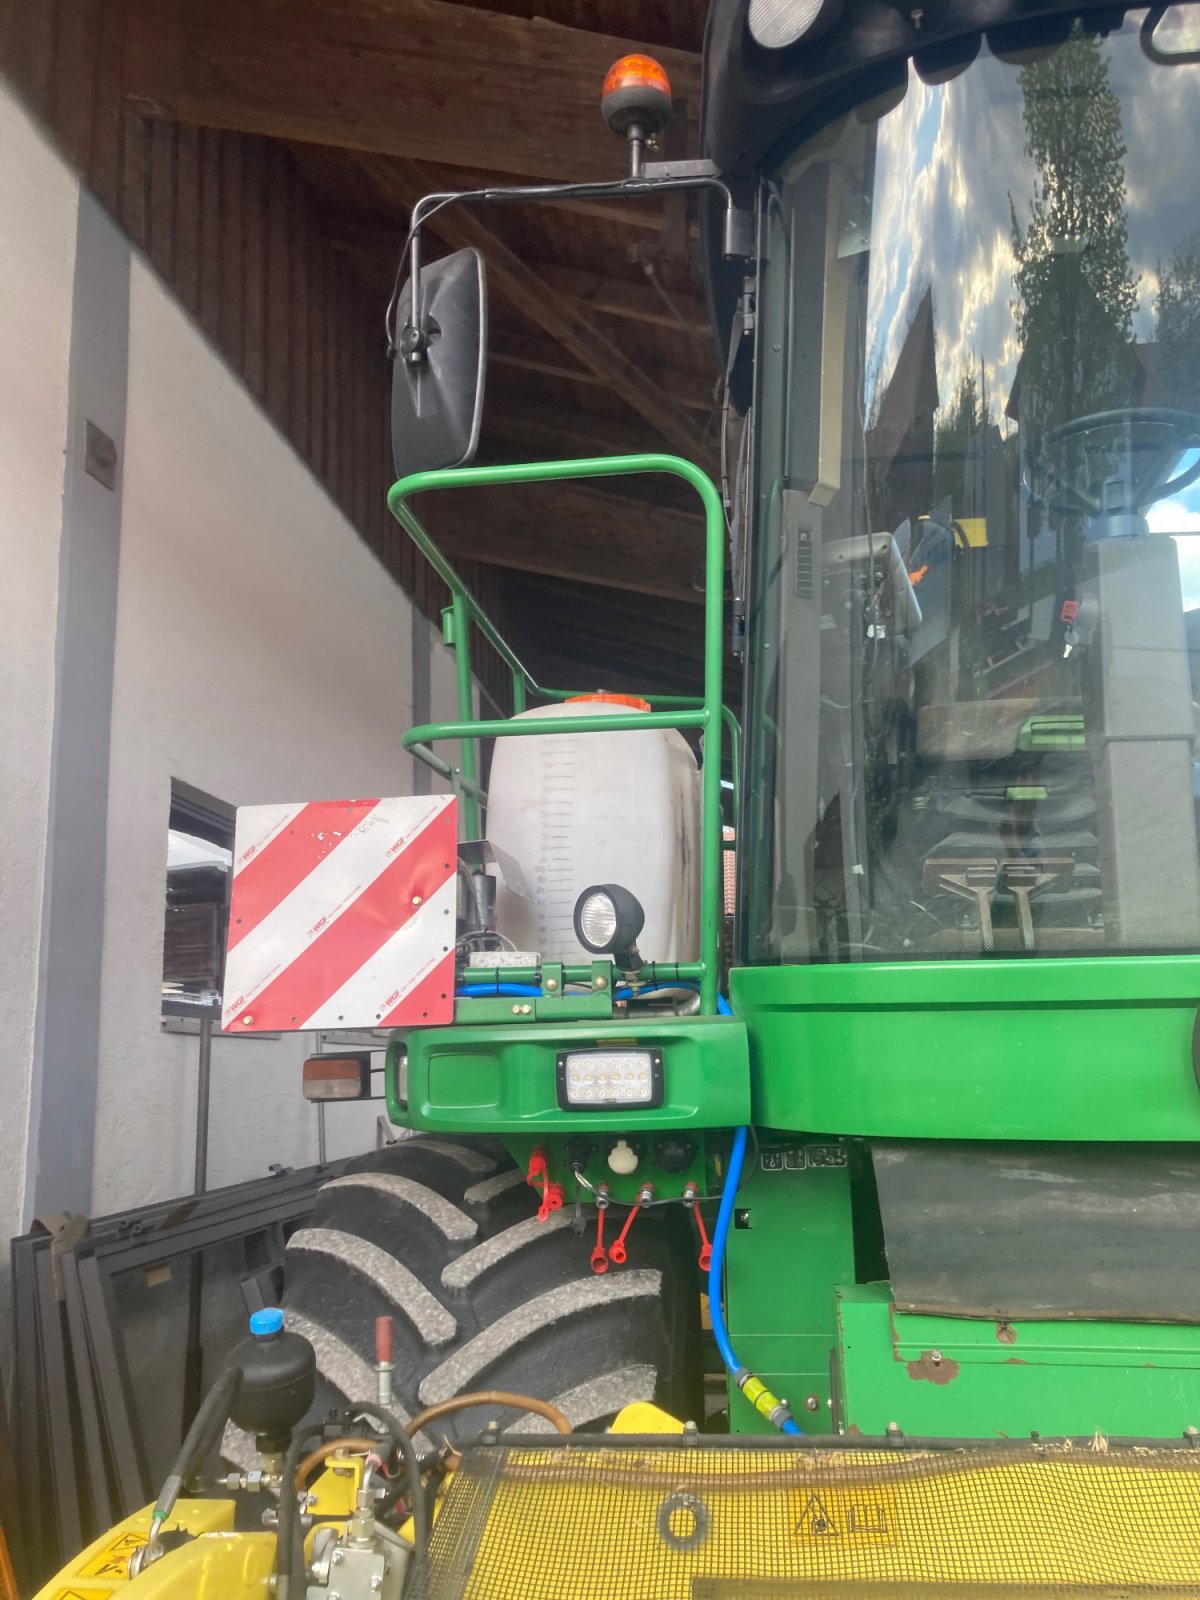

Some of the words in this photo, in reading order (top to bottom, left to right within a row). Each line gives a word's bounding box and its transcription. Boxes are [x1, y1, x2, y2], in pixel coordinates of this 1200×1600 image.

[390, 836, 405, 852] WGF
[312, 915, 328, 931] WGF
[385, 989, 400, 1006] WGF
